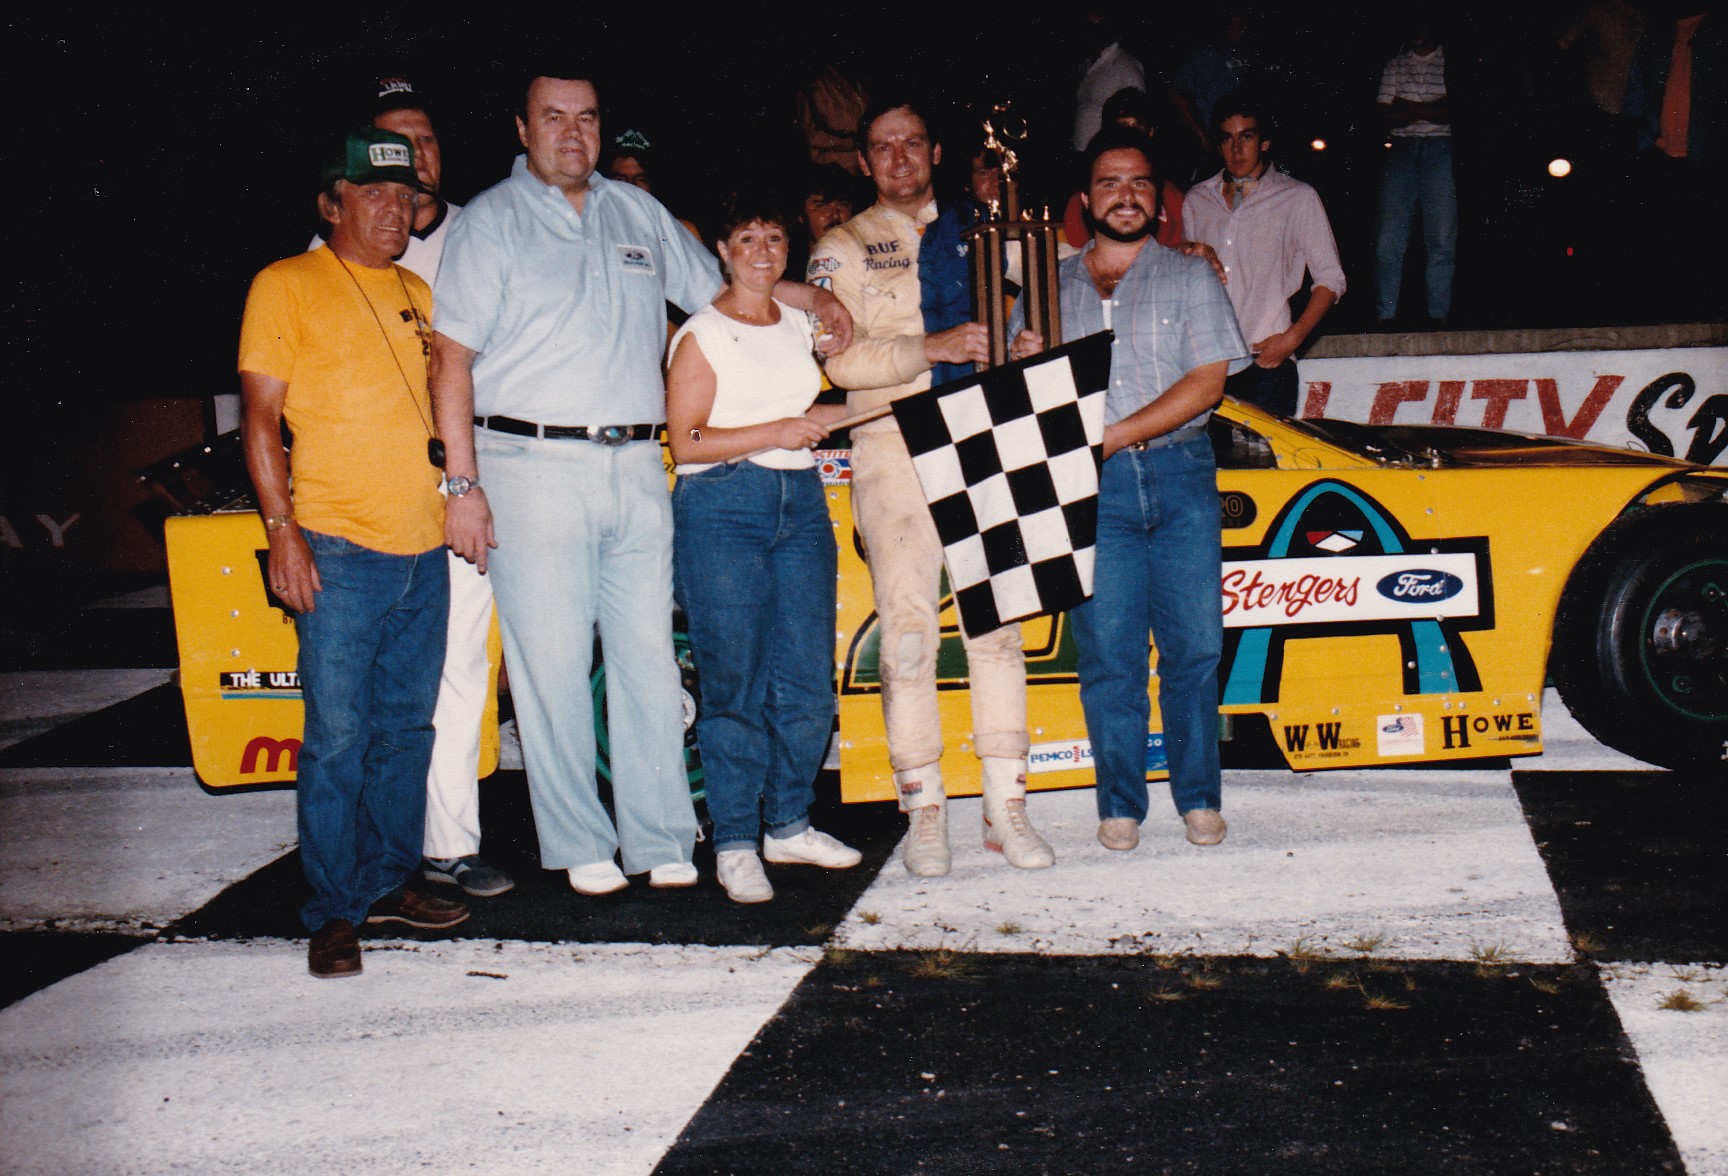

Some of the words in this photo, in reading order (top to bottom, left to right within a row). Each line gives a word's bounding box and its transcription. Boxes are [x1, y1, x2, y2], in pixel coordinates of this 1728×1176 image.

[863, 256, 910, 271] Racing
[1222, 569, 1361, 617] Stengers
[1393, 573, 1445, 597] Ford
[230, 672, 261, 688] THE
[1030, 750, 1073, 764] PEMCO
